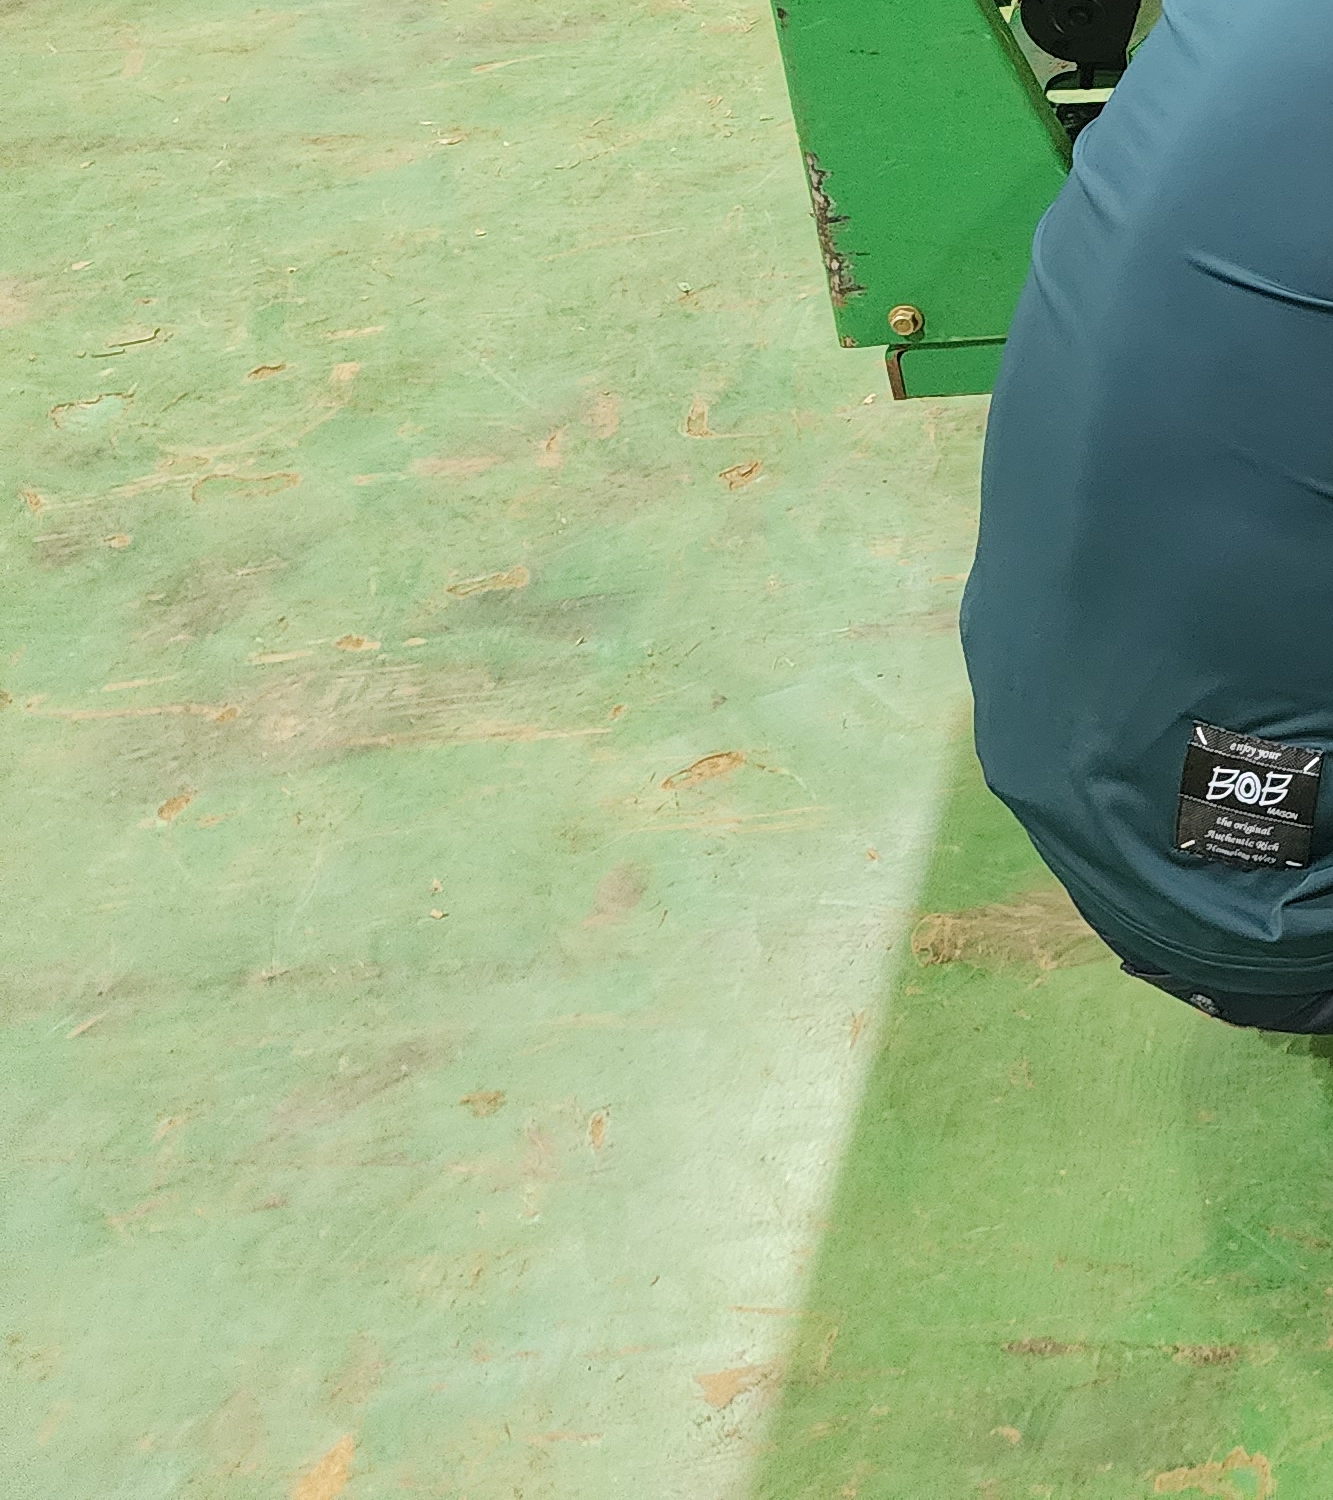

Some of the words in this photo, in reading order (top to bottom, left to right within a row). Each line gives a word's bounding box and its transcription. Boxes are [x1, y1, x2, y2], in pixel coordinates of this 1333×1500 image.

[1229, 741, 1257, 758] enjoy
[1257, 749, 1281, 760] your
[1206, 765, 1293, 807] BOB
[1216, 816, 1233, 828] the
[1233, 820, 1275, 836] original
